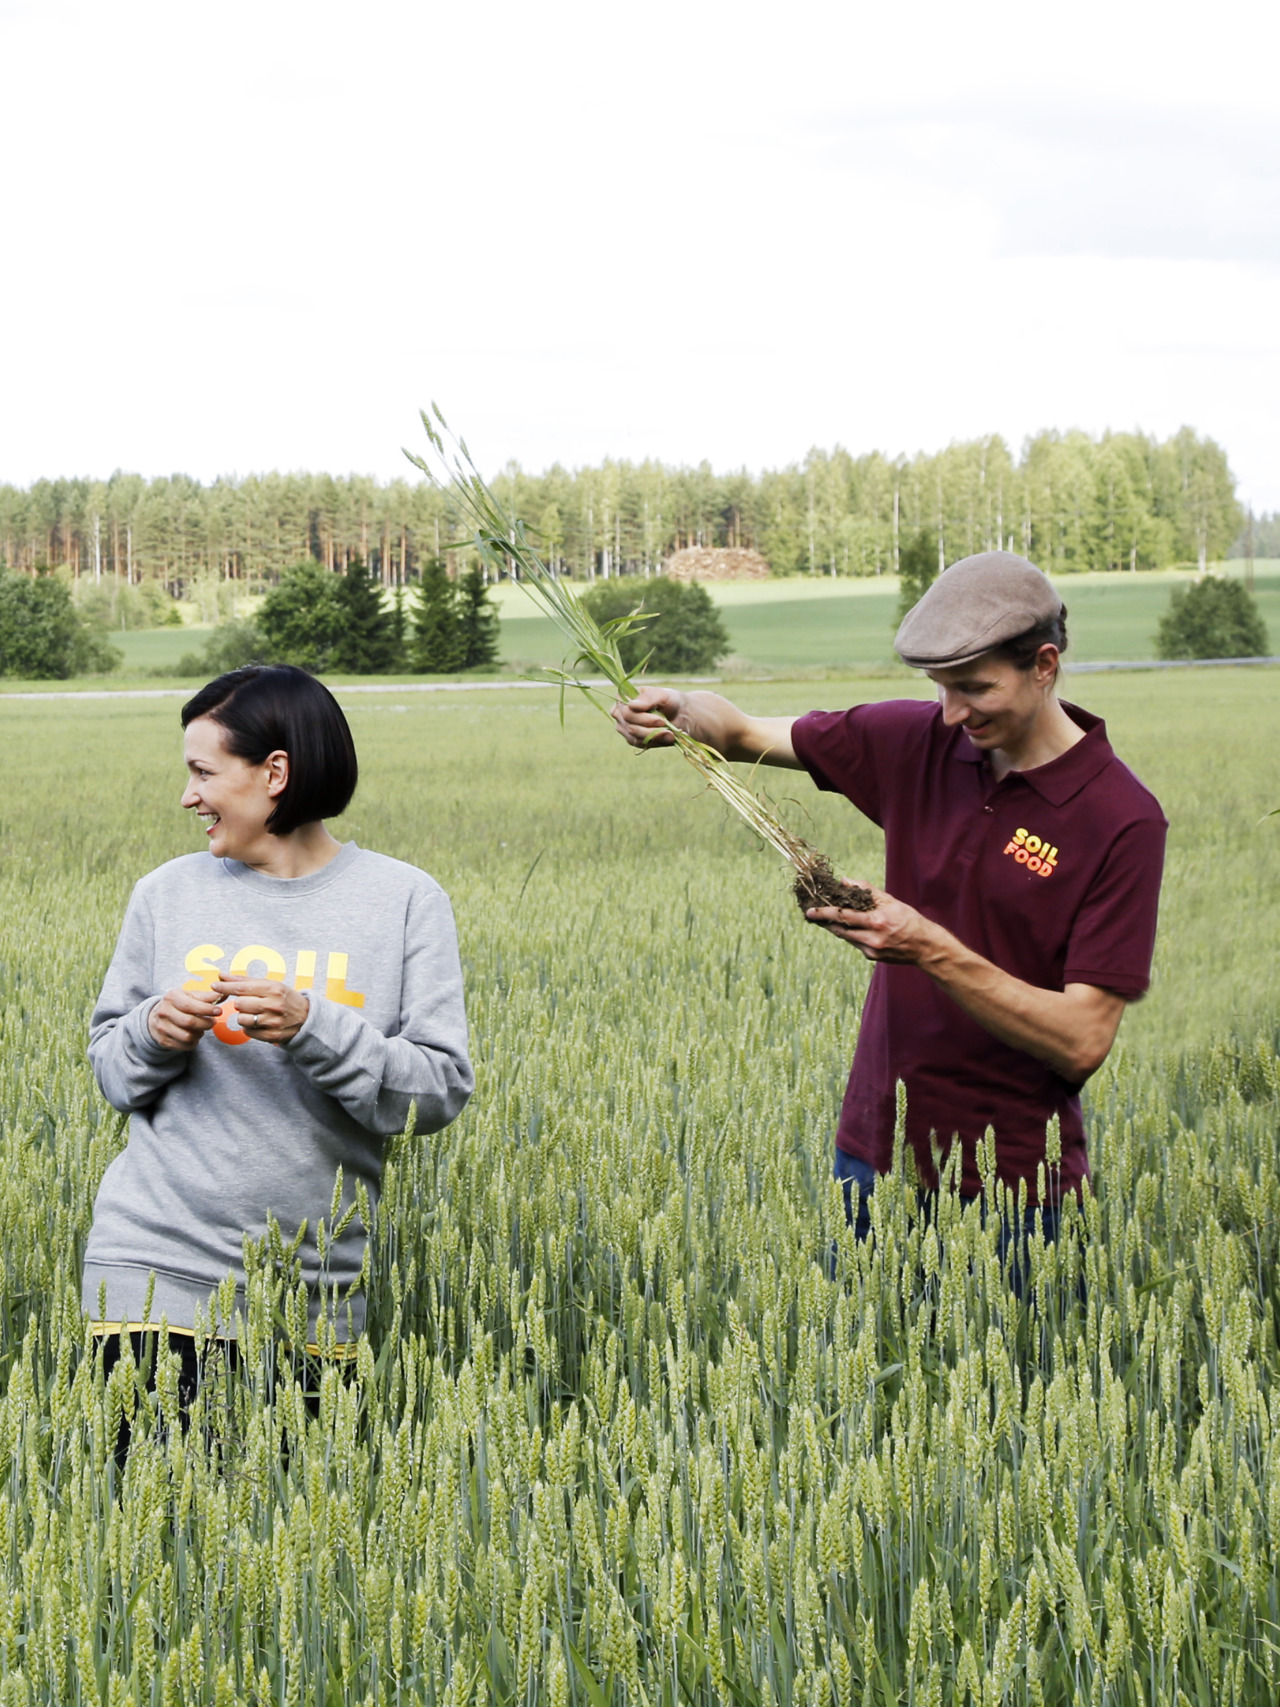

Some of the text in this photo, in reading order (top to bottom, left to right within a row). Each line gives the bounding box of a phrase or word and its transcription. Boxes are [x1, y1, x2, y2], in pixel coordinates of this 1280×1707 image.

[1003, 841, 1053, 877] FOOD
[1012, 828, 1058, 867] SOIL
[182, 944, 365, 1008] SOIL
